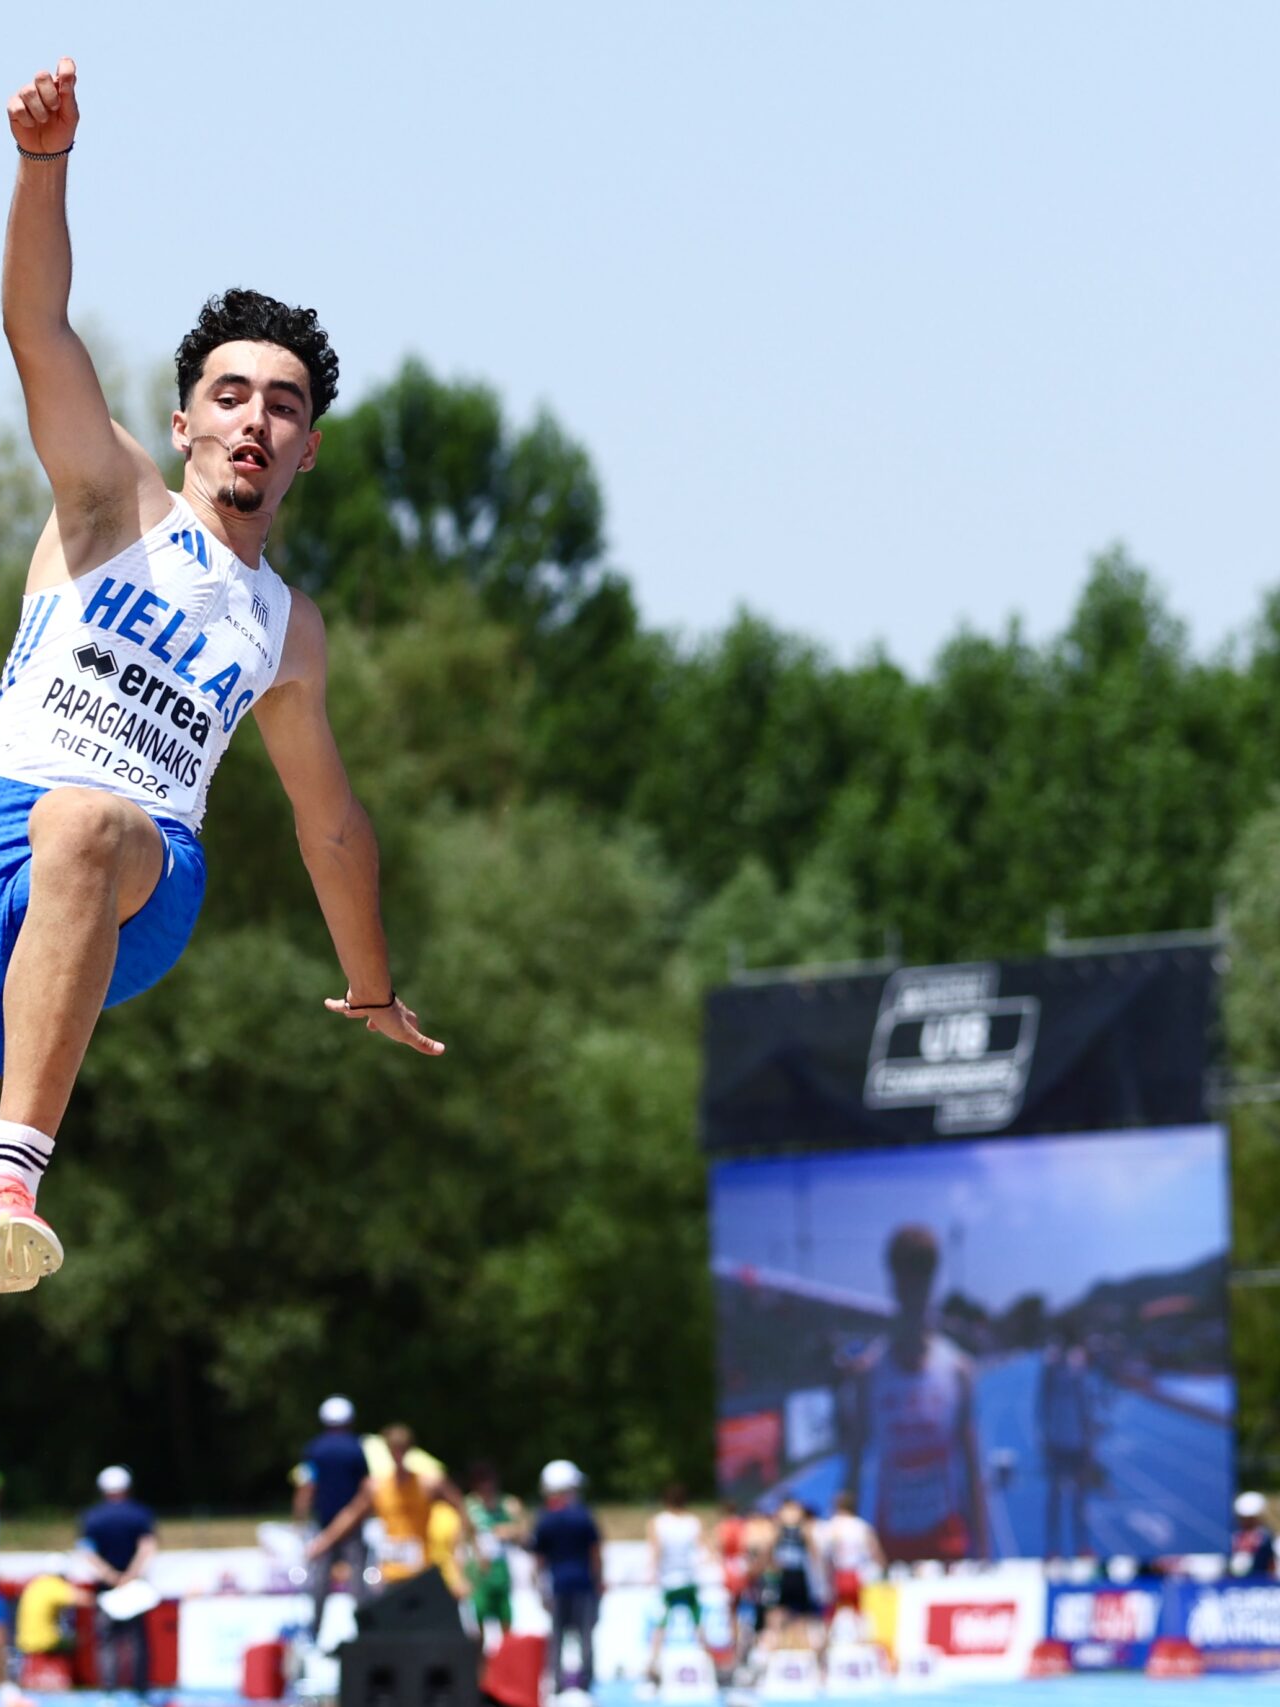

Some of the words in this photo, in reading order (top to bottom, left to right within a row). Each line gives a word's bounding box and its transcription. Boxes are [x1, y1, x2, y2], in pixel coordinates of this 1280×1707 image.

[80, 577, 254, 733] HELLAS
[225, 615, 268, 659] AEGEAN
[42, 677, 202, 788] PAPAGIANNAKIS
[51, 728, 113, 768] RIETI
[112, 759, 170, 799] 2026
